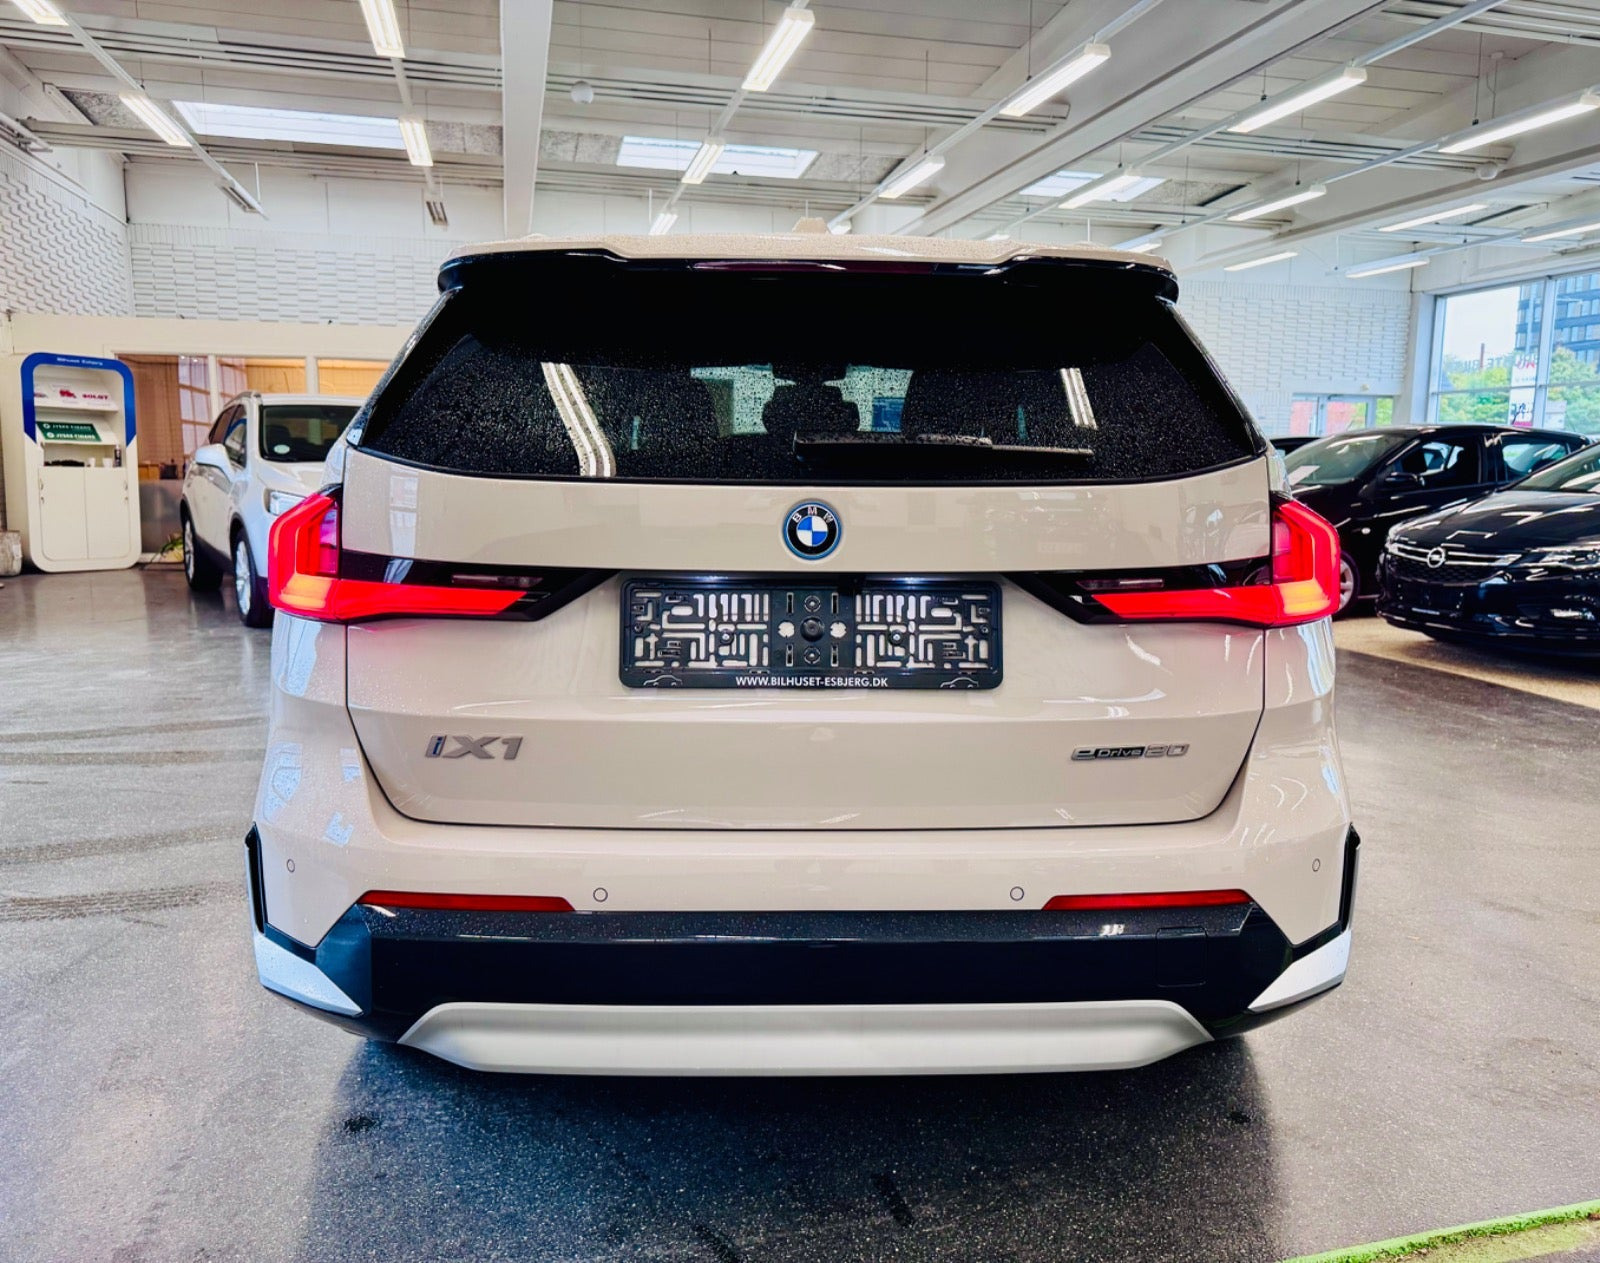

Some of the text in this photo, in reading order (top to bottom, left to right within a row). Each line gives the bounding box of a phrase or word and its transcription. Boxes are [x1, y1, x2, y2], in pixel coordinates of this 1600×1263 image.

[792, 506, 834, 523] BMW
[735, 676, 889, 688] WWW.BILHUSET-ESBJERG.DK
[425, 735, 524, 761] iX1
